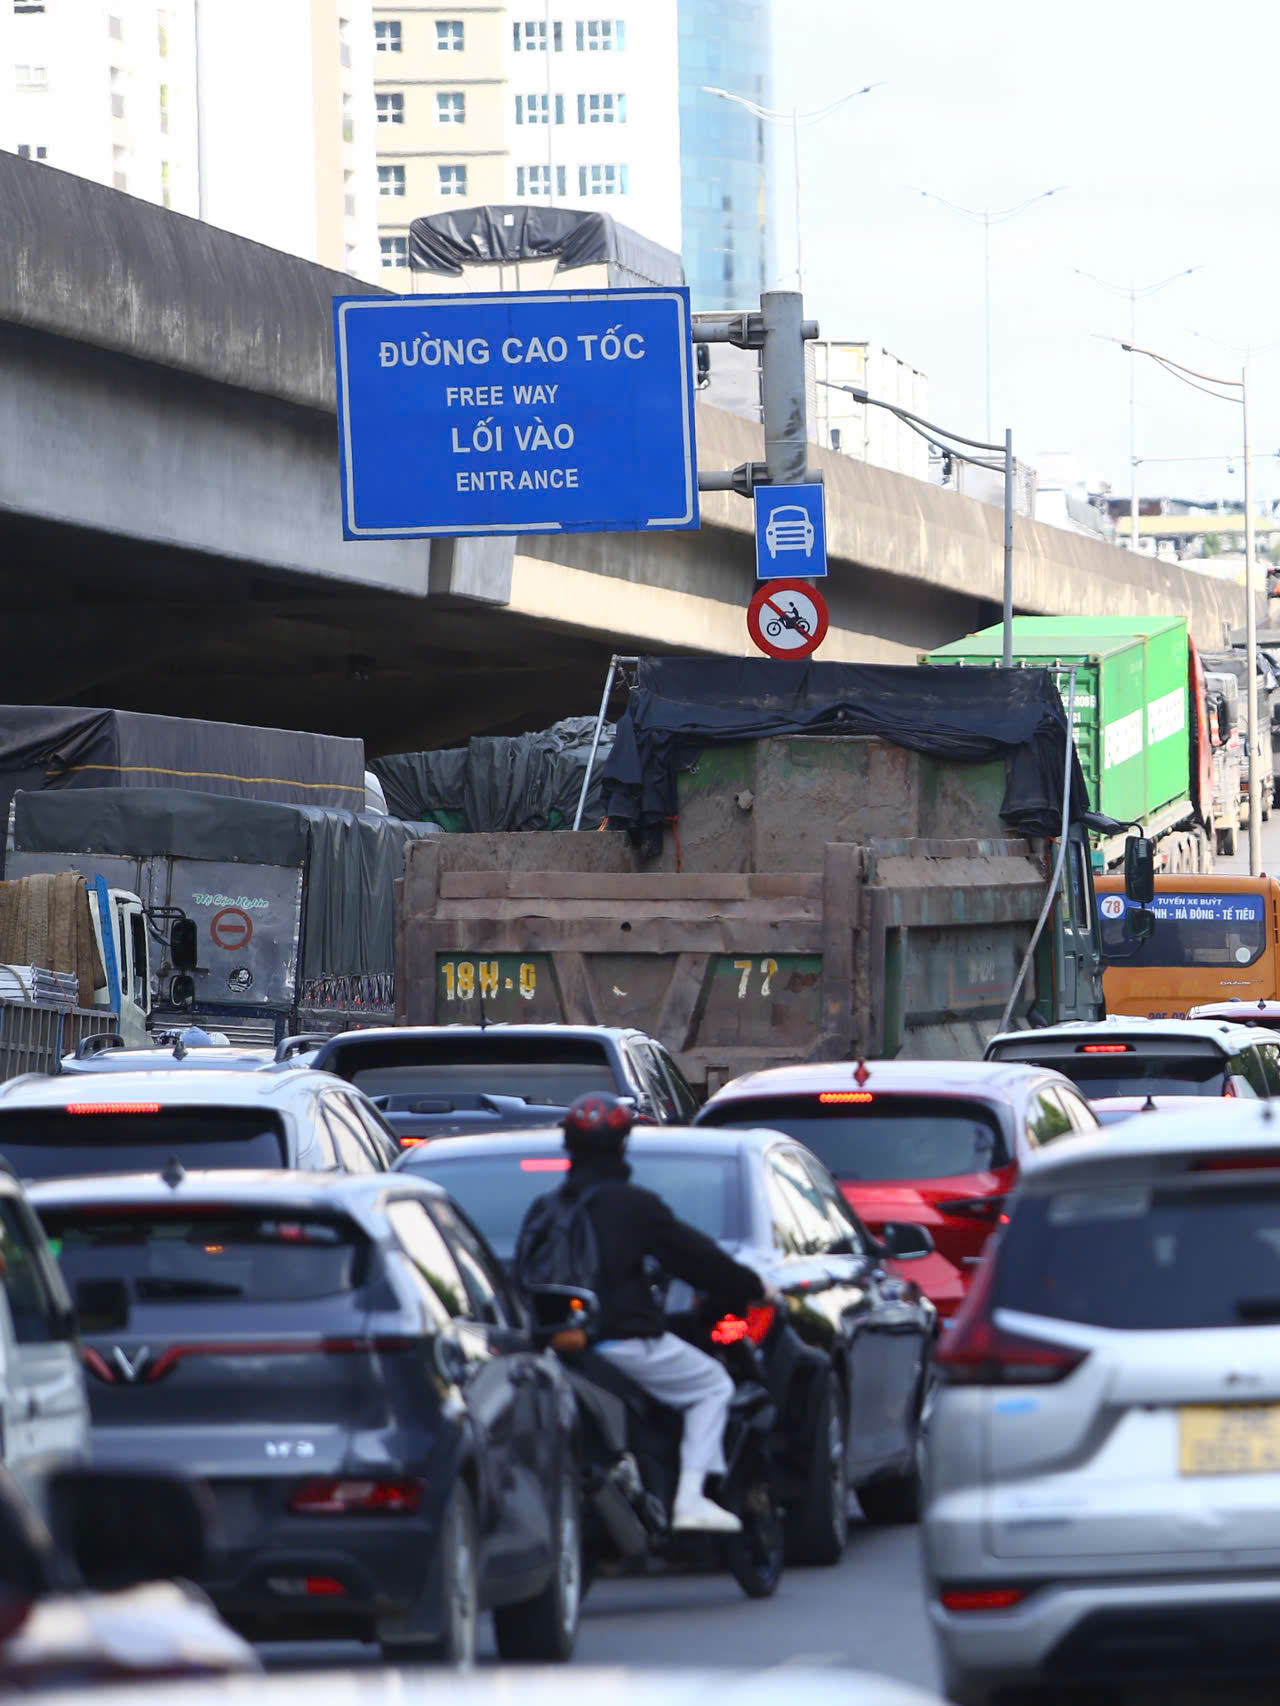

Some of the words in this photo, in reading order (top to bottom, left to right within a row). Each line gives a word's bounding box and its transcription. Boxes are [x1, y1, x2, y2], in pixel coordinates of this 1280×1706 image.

[379, 331, 491, 368] ĐƯỜNG
[501, 336, 569, 365] CAO
[577, 324, 646, 362] TỐC
[446, 385, 504, 407] FREE
[513, 384, 559, 405] WAY
[452, 417, 503, 453] LỐI
[514, 416, 575, 451] VÀO
[456, 469, 579, 492] ENTRANCE
[1105, 901, 1121, 914] 78
[1176, 906, 1188, 919] HÀ
[1189, 907, 1214, 920] ĐÔNG
[1222, 905, 1234, 920] TẾ
[1235, 907, 1255, 920] TIÊU
